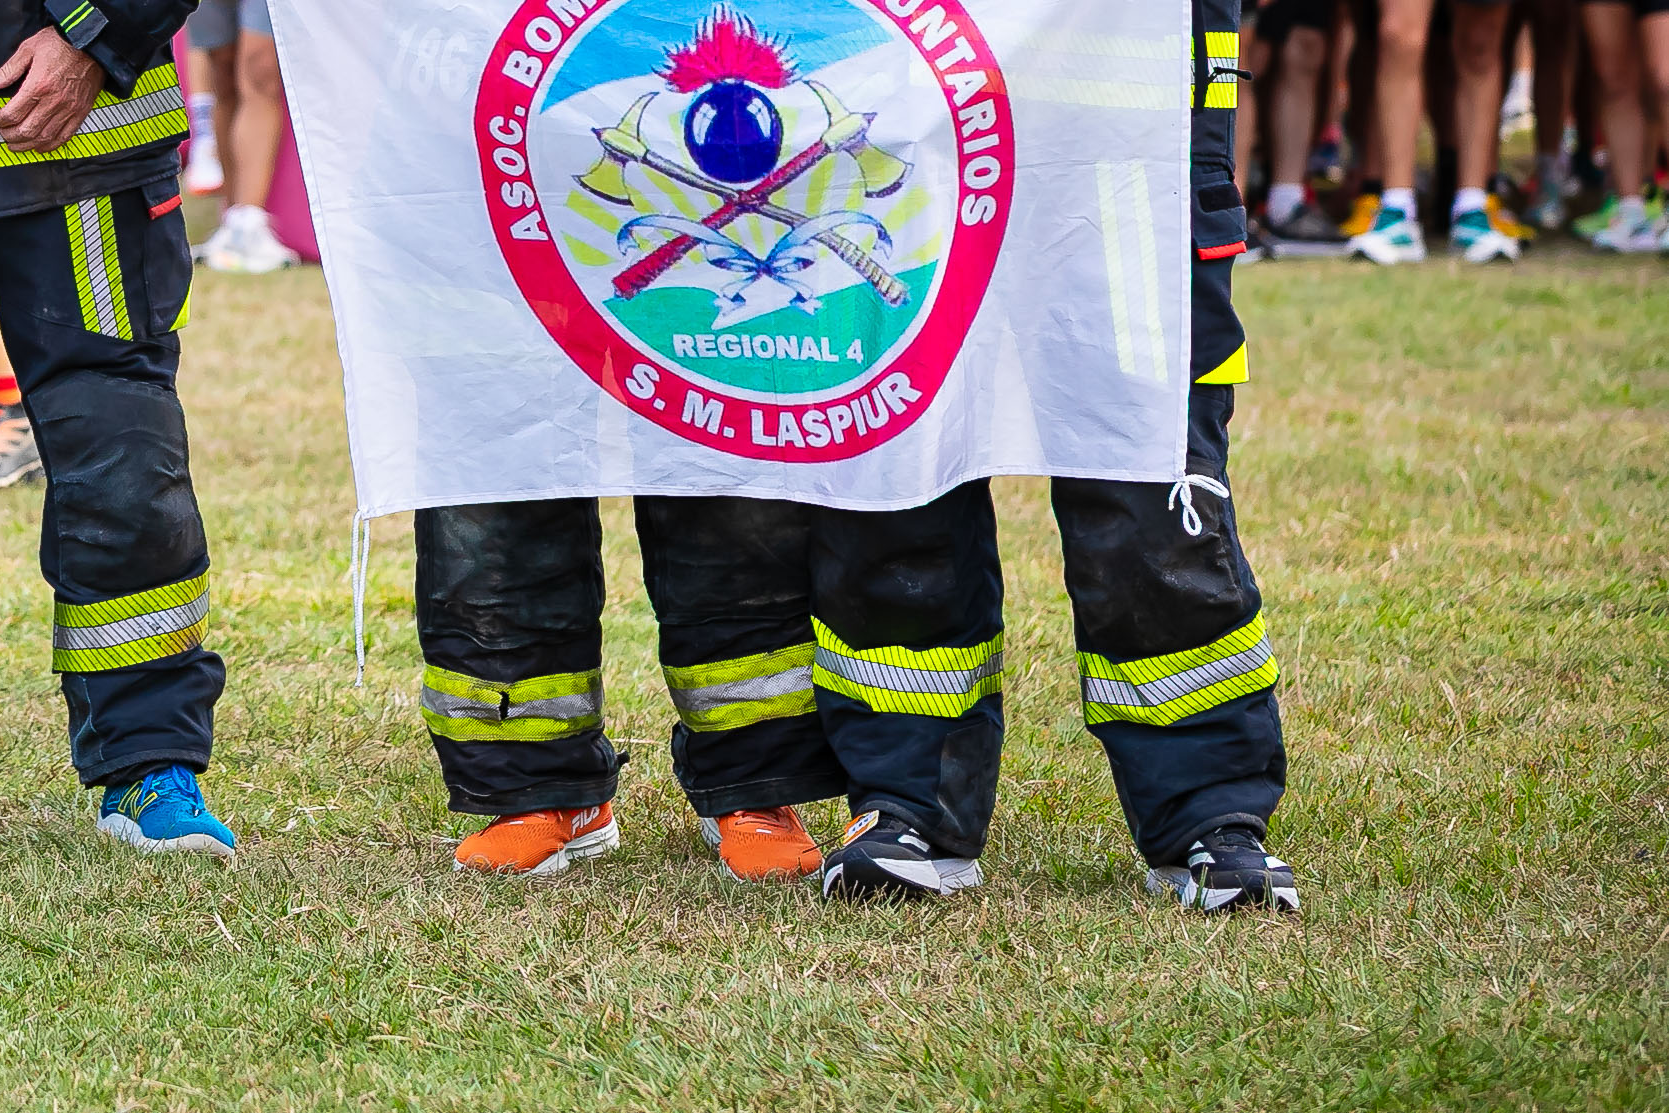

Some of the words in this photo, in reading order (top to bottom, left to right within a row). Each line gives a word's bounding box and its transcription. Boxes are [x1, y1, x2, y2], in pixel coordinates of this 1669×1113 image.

[488, 104, 550, 241] ASOC.
[672, 333, 839, 362] REGIONAL
[846, 339, 864, 364] 4
[624, 362, 666, 411] S.
[681, 389, 735, 438] M.
[750, 371, 923, 448] LASPIUR
